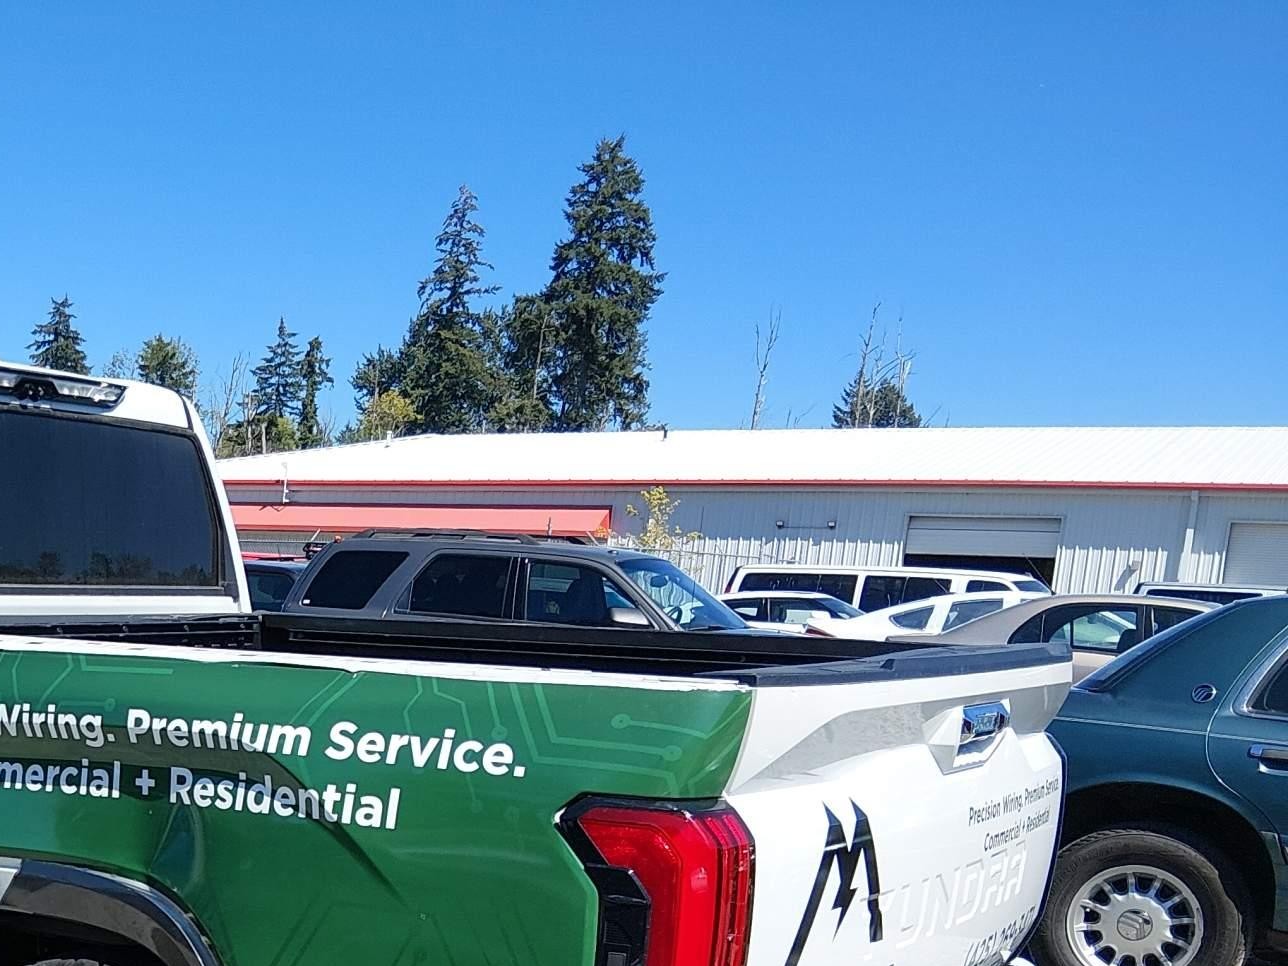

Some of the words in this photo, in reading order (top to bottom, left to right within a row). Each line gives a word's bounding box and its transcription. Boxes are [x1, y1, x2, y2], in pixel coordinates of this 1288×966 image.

[126, 708, 311, 756] Premium
[324, 721, 527, 778] Service.
[169, 766, 402, 830] Residential
[968, 800, 1001, 829] Precision
[983, 819, 1021, 852] Commercial
